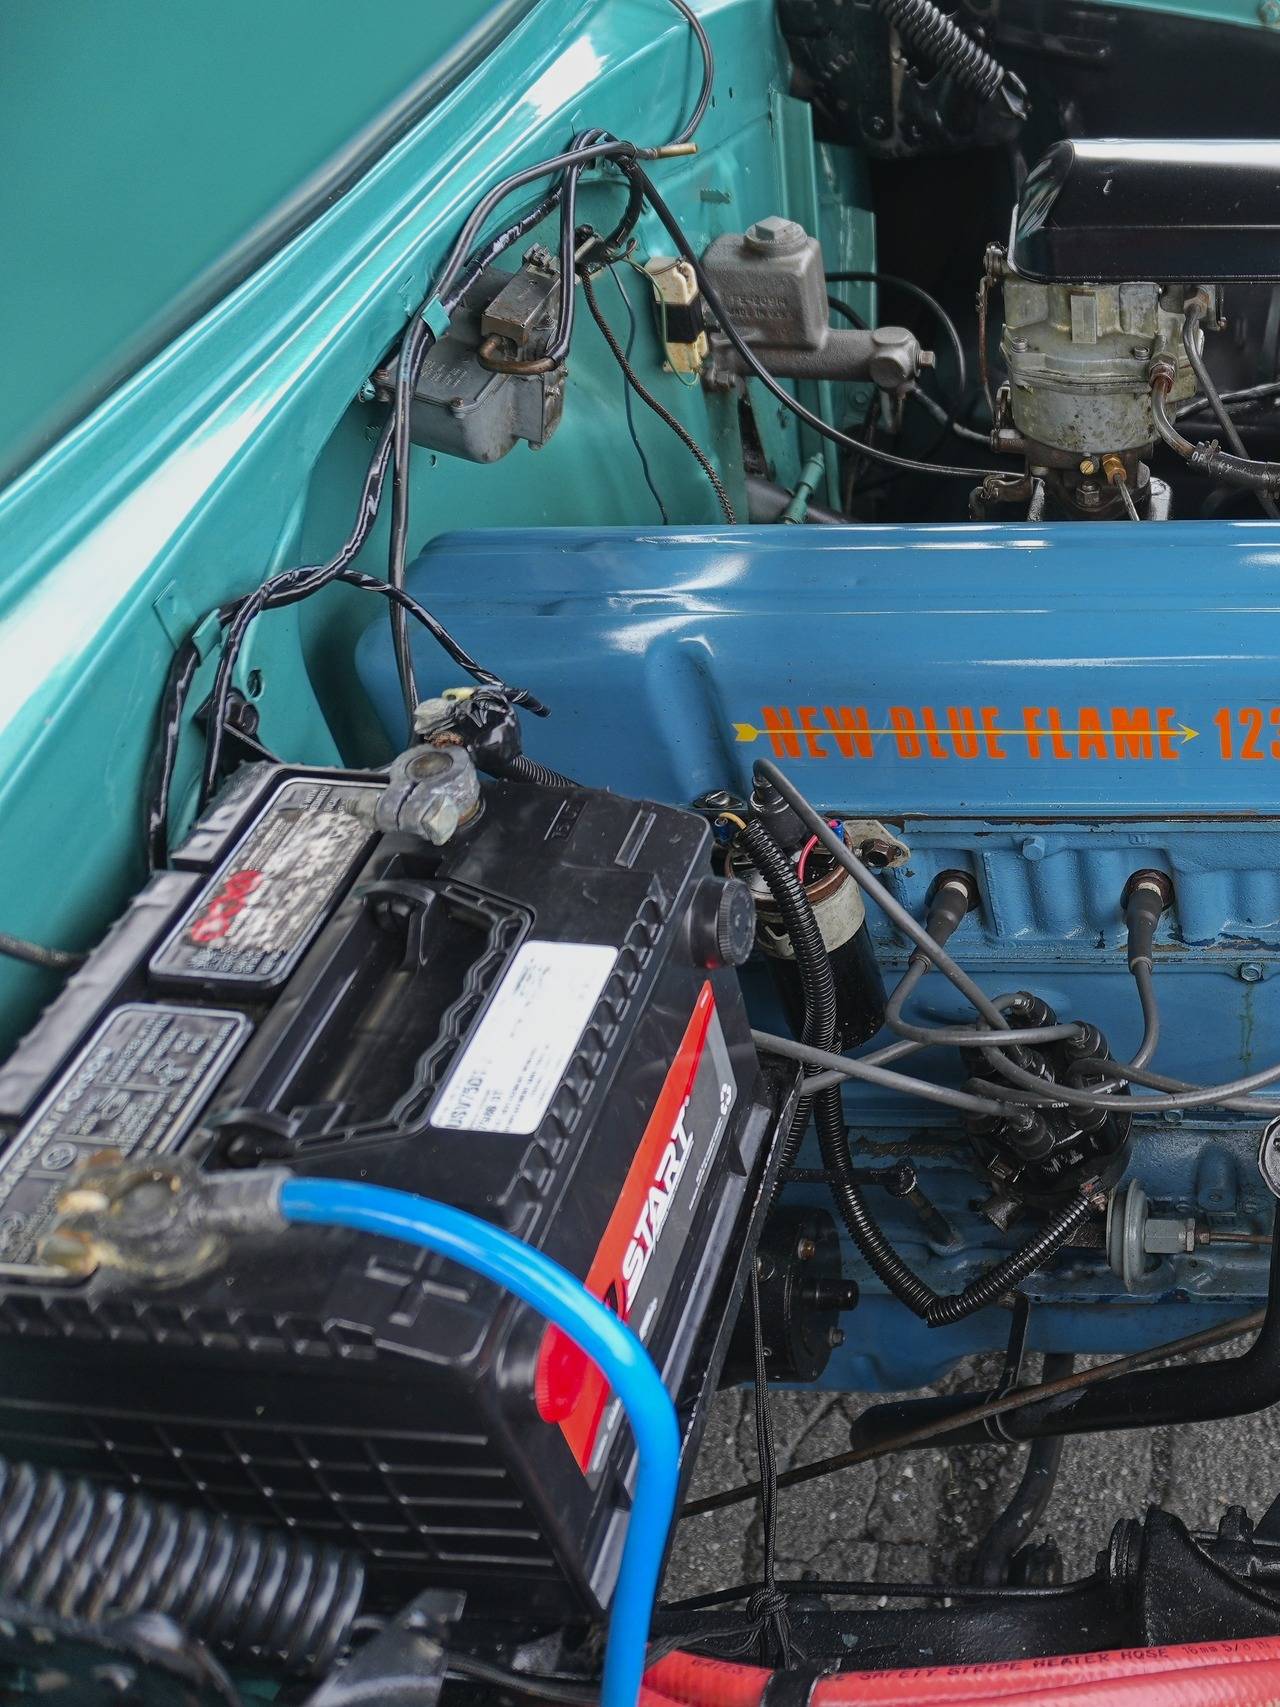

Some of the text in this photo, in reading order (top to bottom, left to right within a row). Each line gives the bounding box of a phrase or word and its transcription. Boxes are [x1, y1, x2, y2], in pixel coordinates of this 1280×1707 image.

[761, 707, 873, 758] NEW
[890, 707, 1006, 759] BLUE
[1021, 707, 1181, 760] FLAME
[622, 1103, 691, 1285] START
[1033, 1653, 1110, 1669] HEATER
[1120, 1649, 1169, 1661] HOSE
